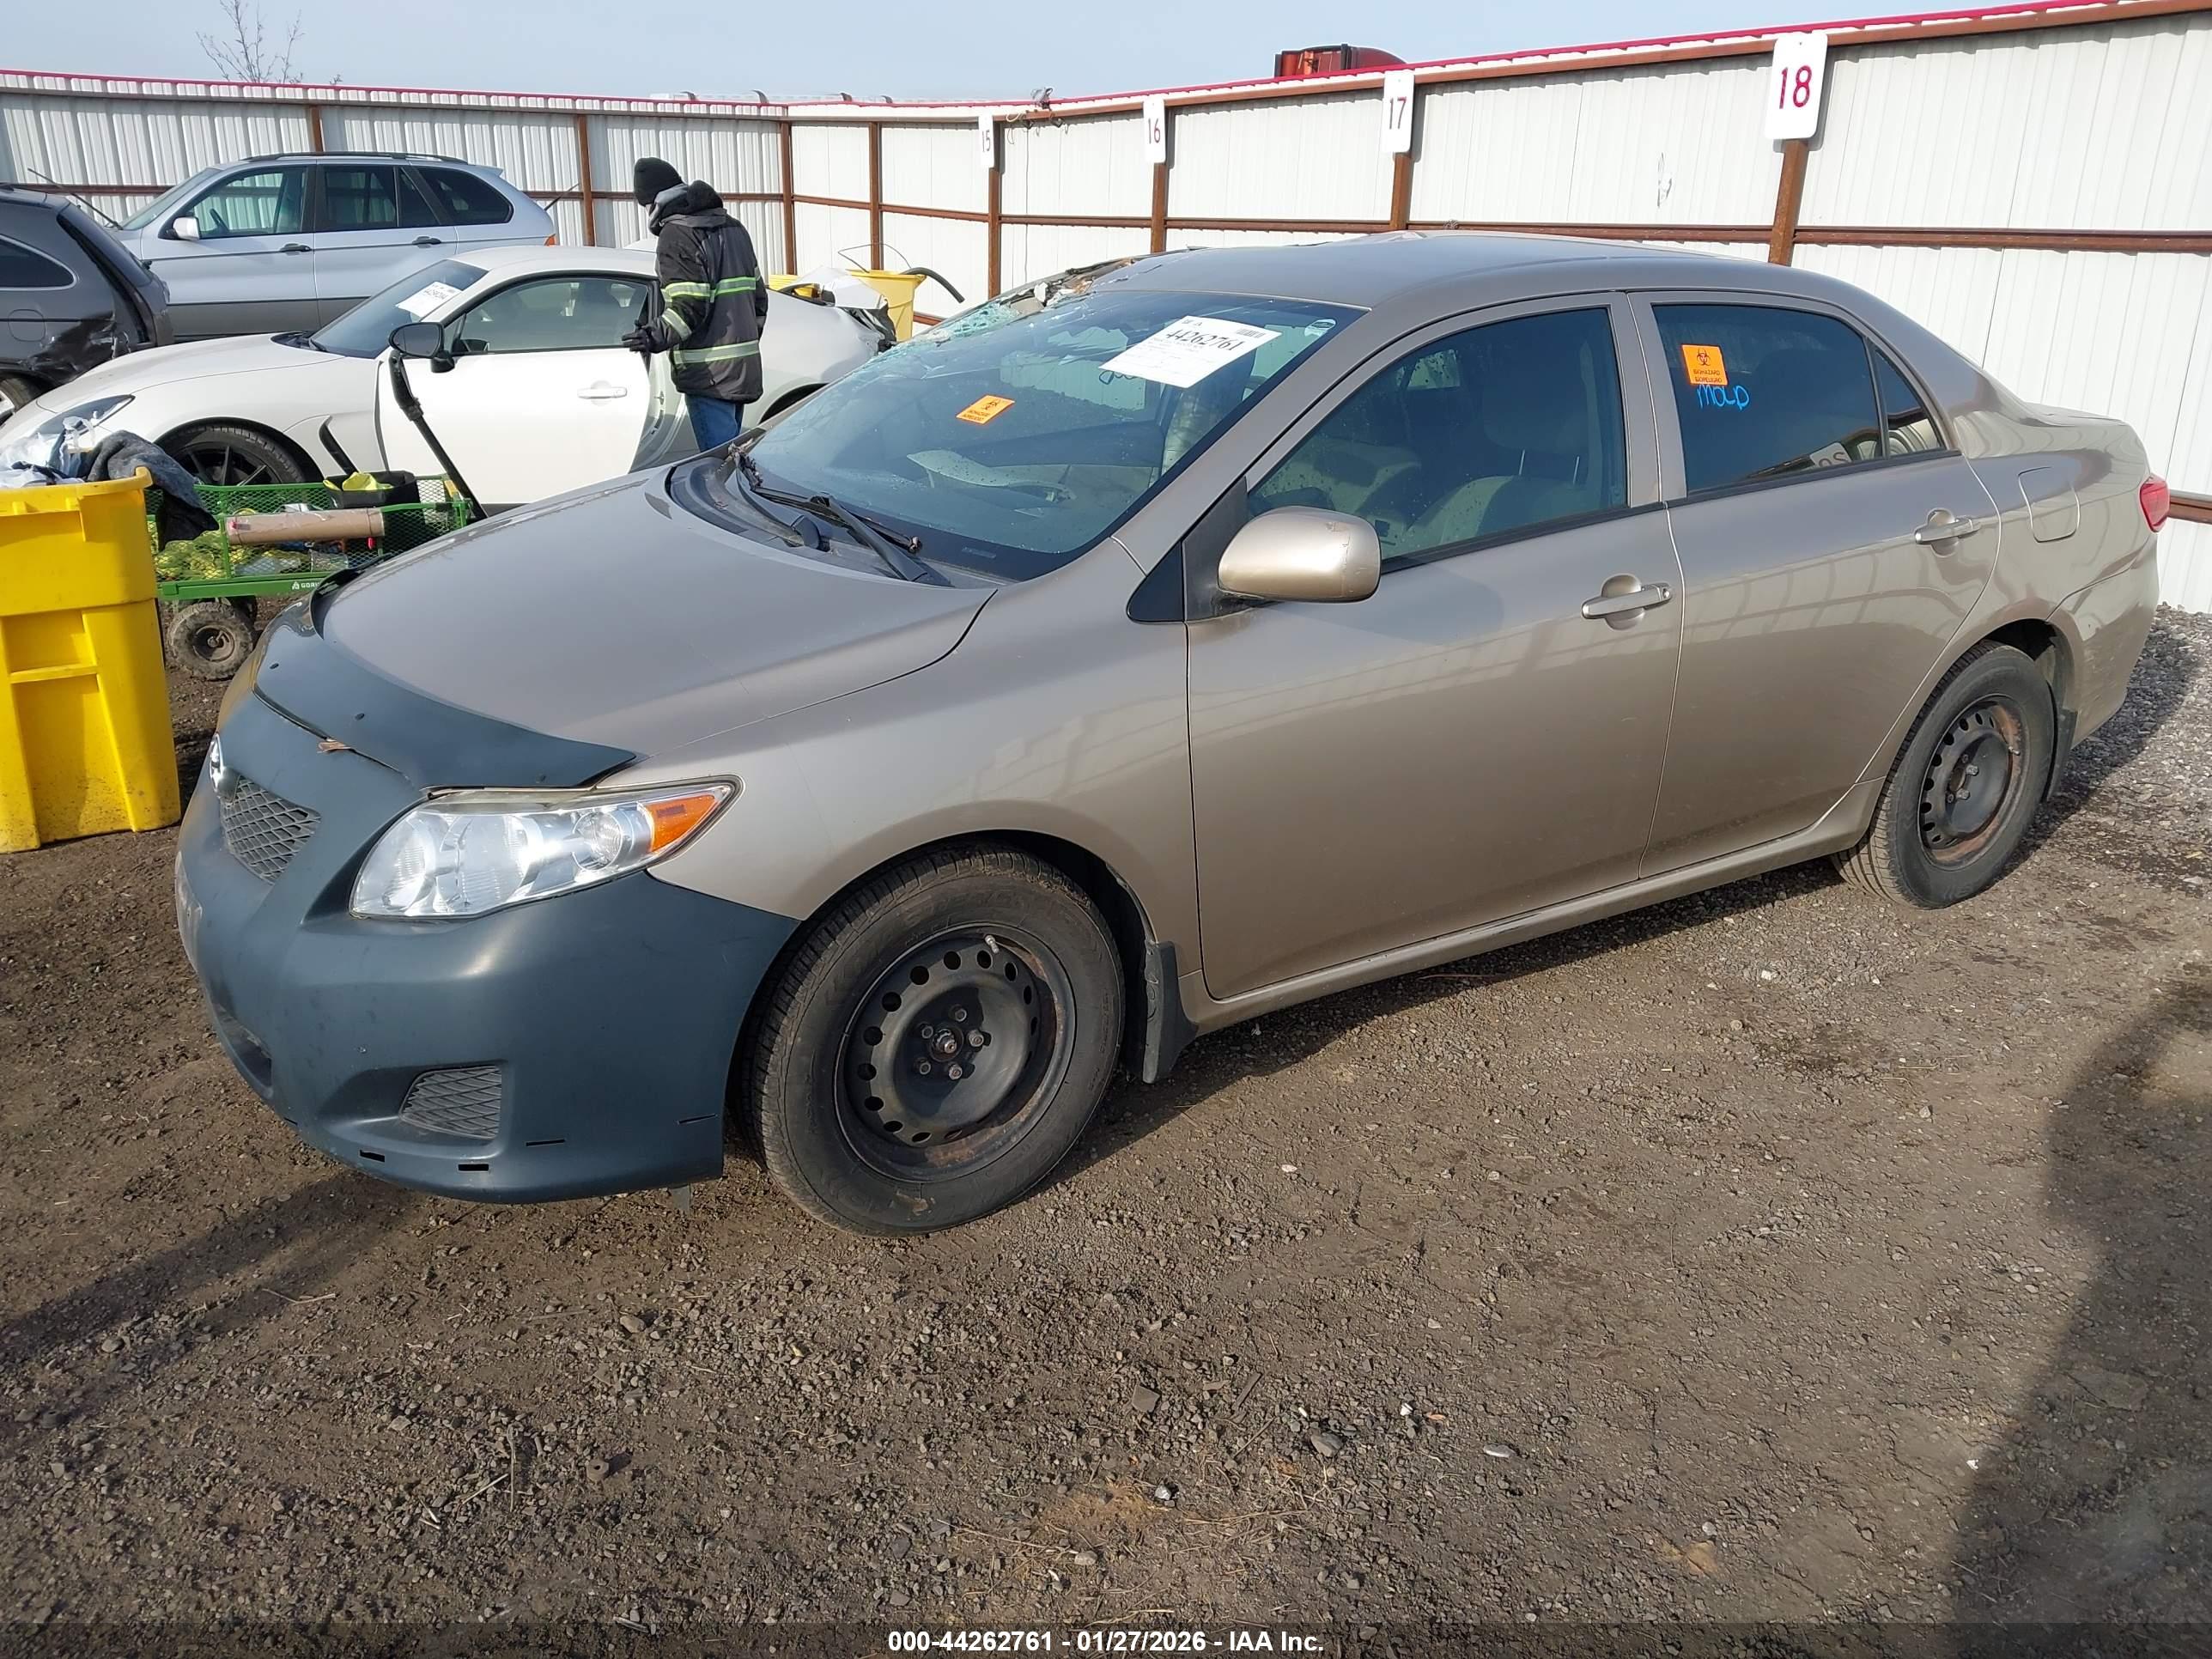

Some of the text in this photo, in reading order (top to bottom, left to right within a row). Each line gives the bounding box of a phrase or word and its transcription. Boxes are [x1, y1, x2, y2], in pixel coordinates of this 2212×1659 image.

[1779, 65, 1812, 109] 18
[1389, 96, 1407, 130] 17
[981, 130, 991, 152] 15
[1148, 118, 1160, 144] 16
[1167, 329, 1245, 351] 44262761
